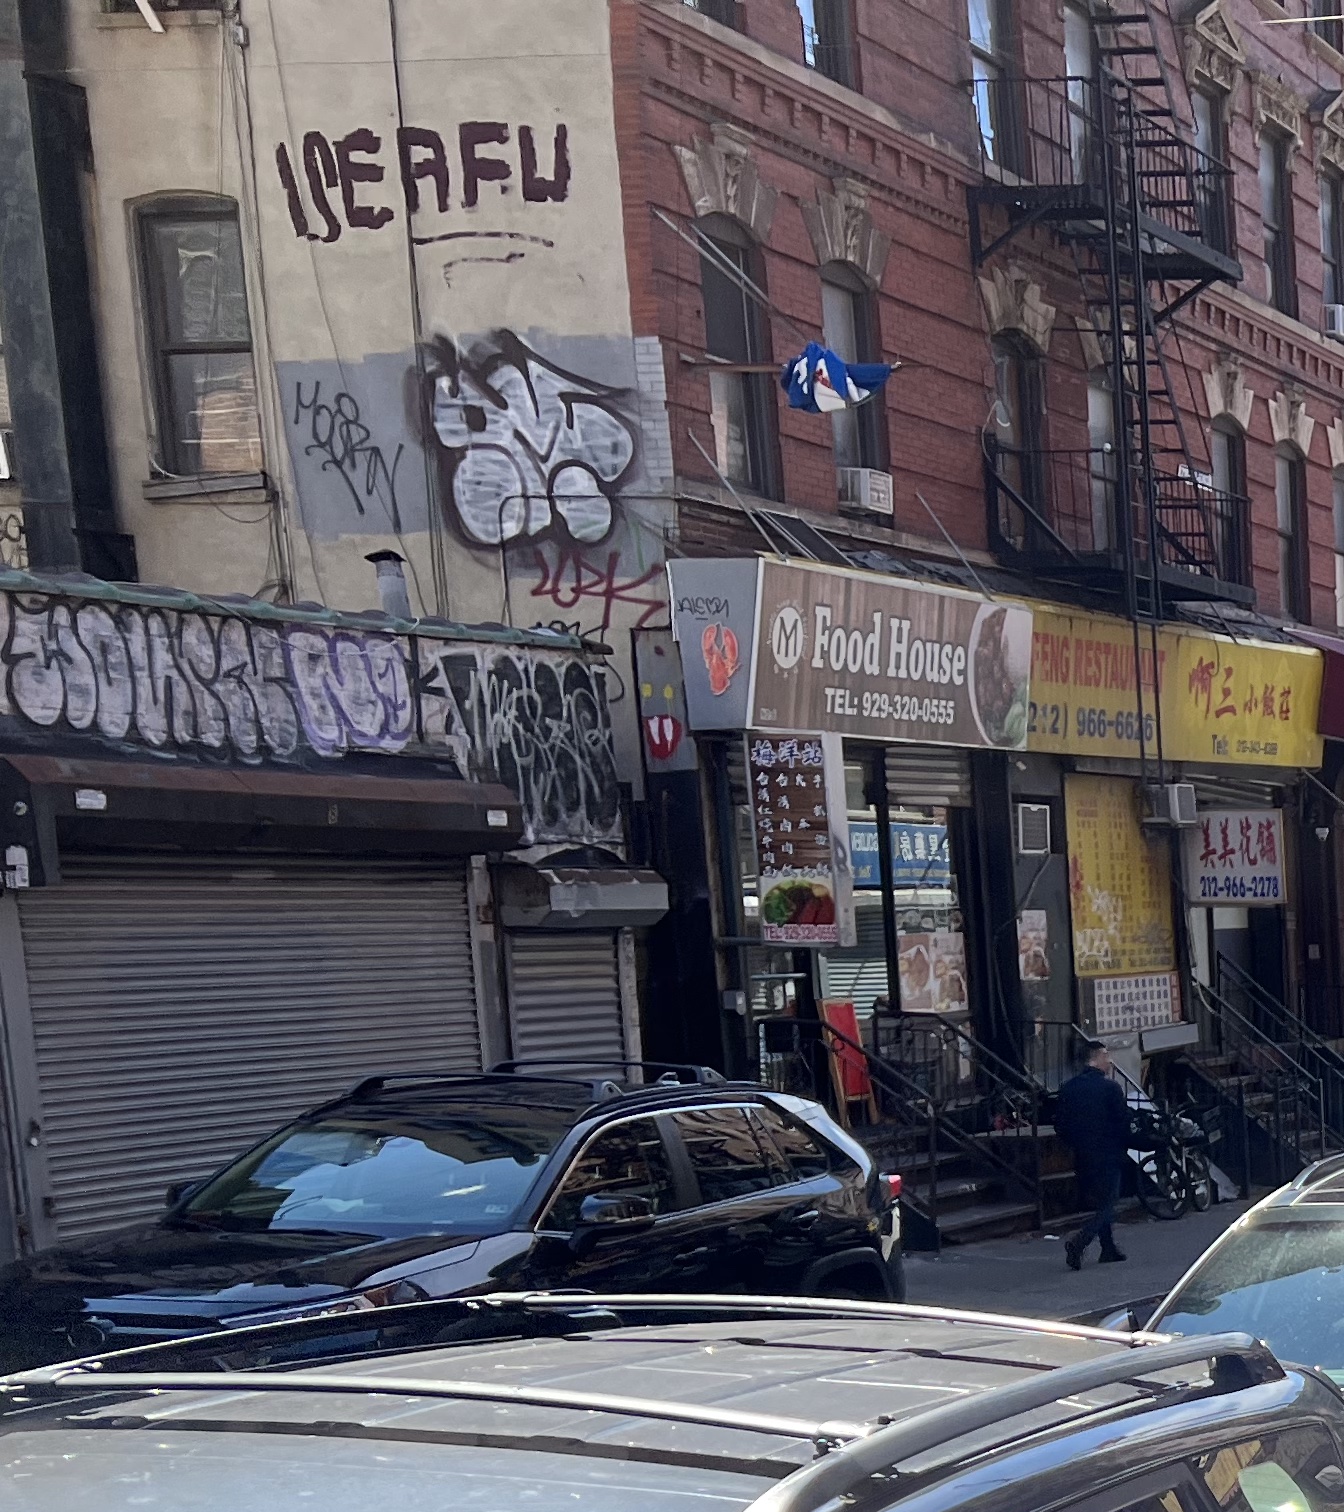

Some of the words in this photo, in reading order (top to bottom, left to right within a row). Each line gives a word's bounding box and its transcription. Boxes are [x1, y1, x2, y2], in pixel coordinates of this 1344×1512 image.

[811, 605, 883, 677] Food
[886, 617, 966, 686] House
[825, 687, 858, 716] TEL:
[862, 691, 955, 725] 929-320-0555
[1200, 875, 1280, 898] 212-966-2278
